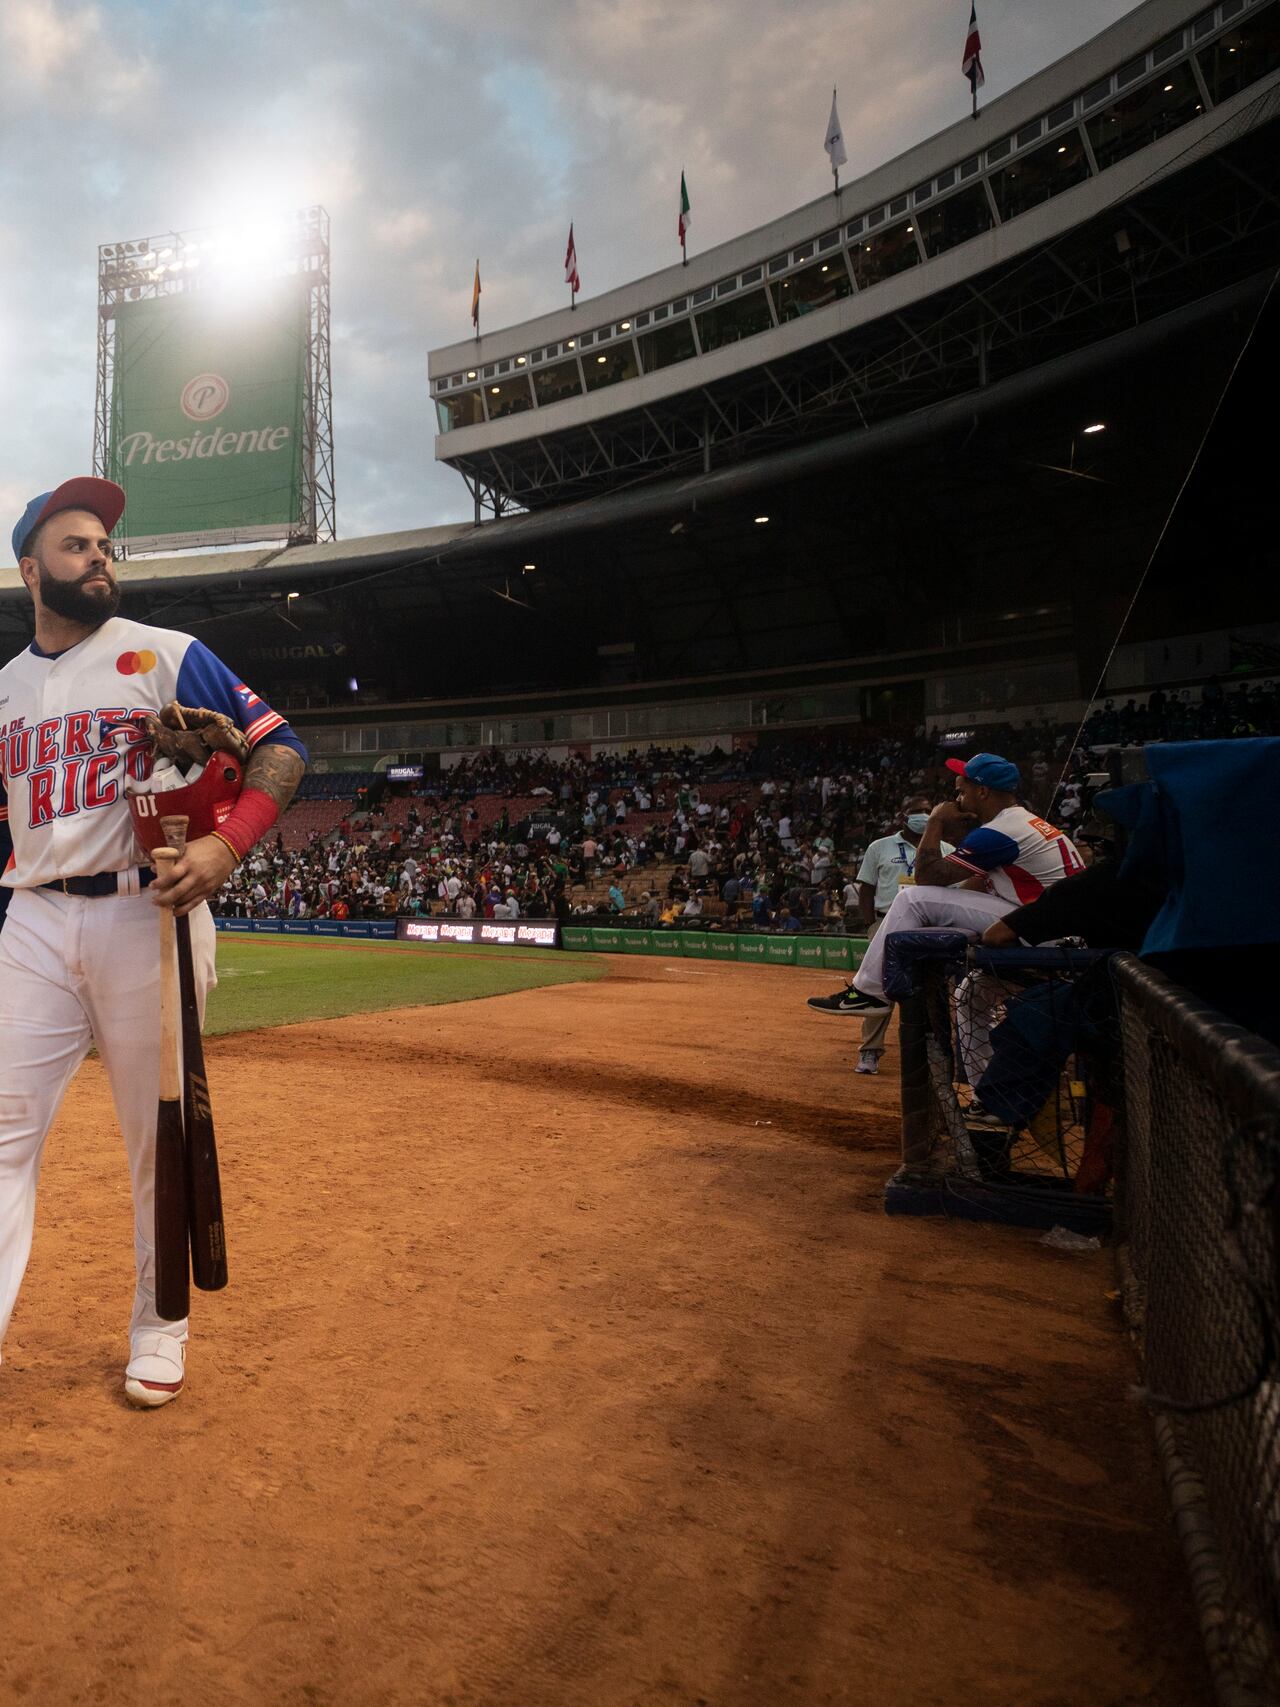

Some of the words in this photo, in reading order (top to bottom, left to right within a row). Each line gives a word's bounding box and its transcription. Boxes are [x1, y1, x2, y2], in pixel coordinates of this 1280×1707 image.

[119, 426, 290, 466] Presidente
[9, 716, 26, 733] DE
[390, 767, 415, 775] BRUGAL
[27, 740, 153, 829] RICO
[135, 794, 158, 818] 10
[407, 923, 439, 937] Mexana
[440, 924, 474, 938] Mexana
[481, 925, 516, 938] Mexana
[518, 926, 555, 939] Mexana
